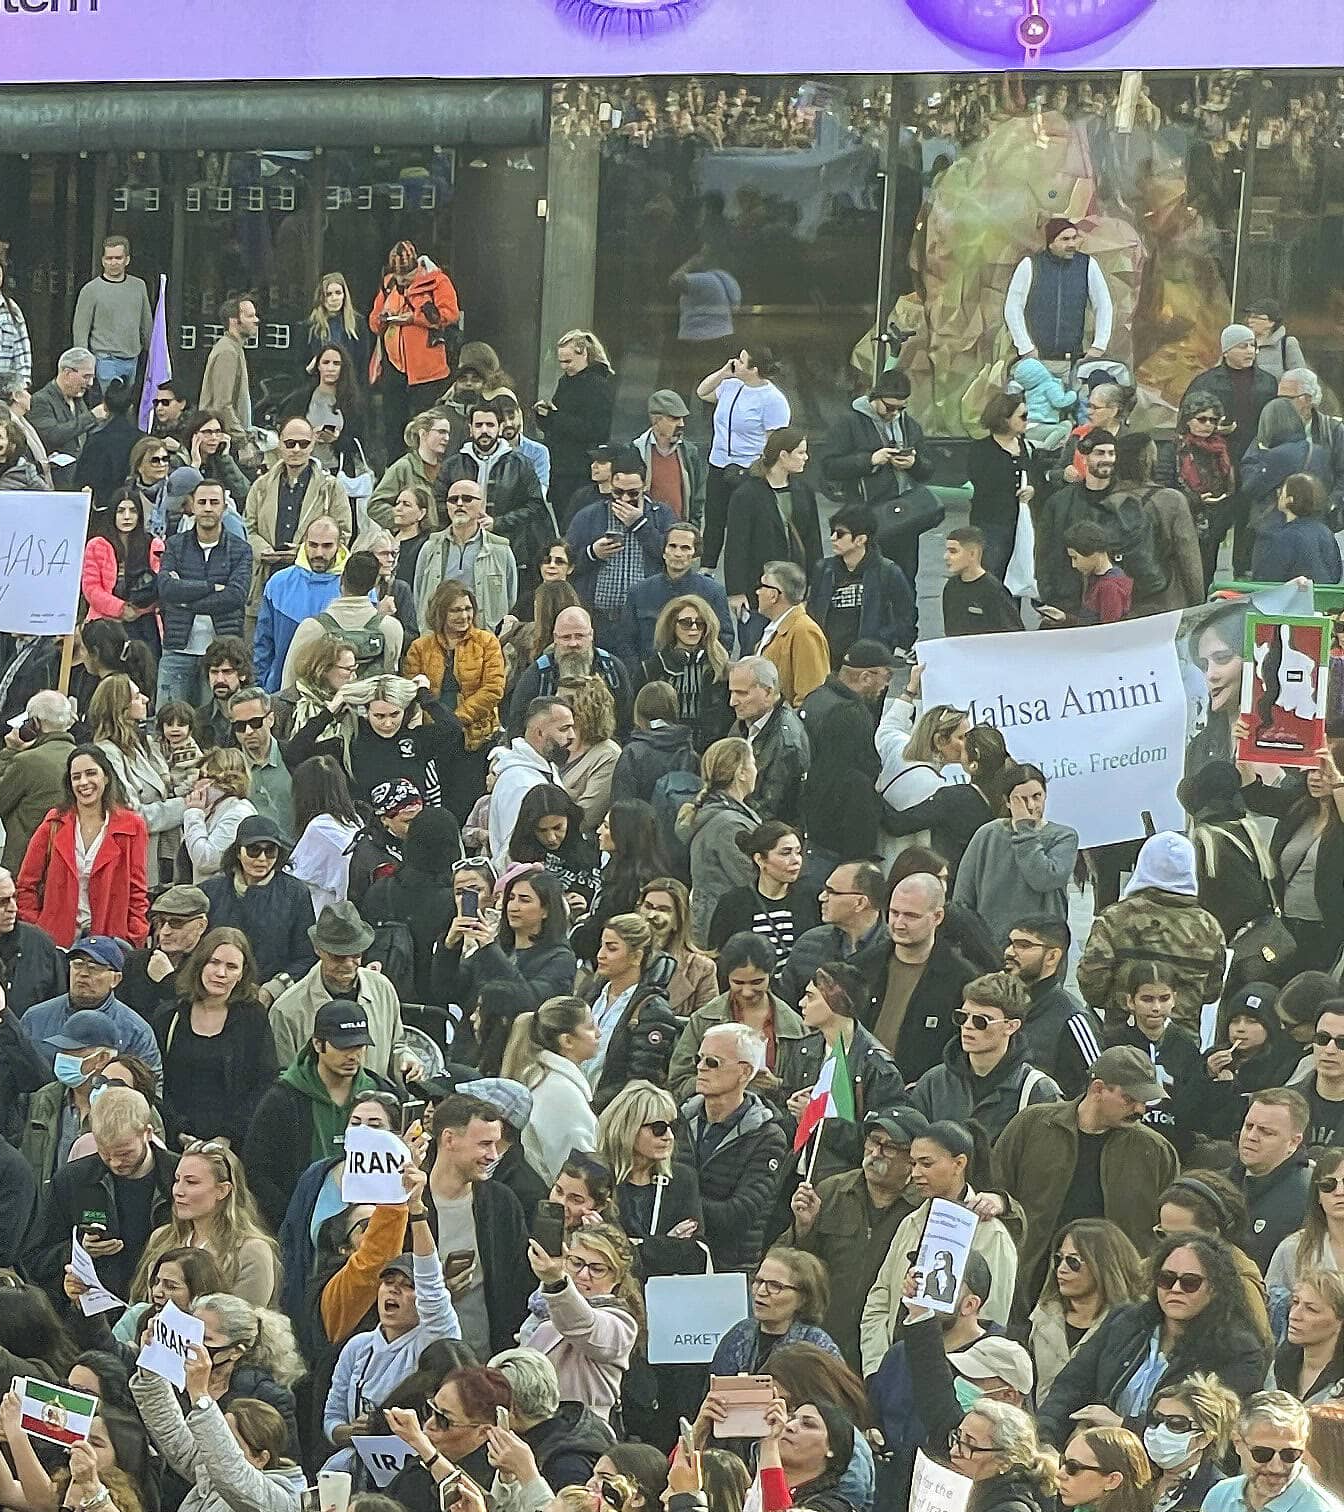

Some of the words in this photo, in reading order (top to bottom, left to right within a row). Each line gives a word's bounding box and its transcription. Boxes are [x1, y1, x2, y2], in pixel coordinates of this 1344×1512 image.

[1061, 671, 1163, 719] Amini
[1089, 745, 1168, 774] Freedom
[349, 1152, 406, 1175] IRAN
[154, 1319, 191, 1358] IRAN
[673, 1333, 721, 1346] ARKET
[935, 1483, 954, 1500] the
